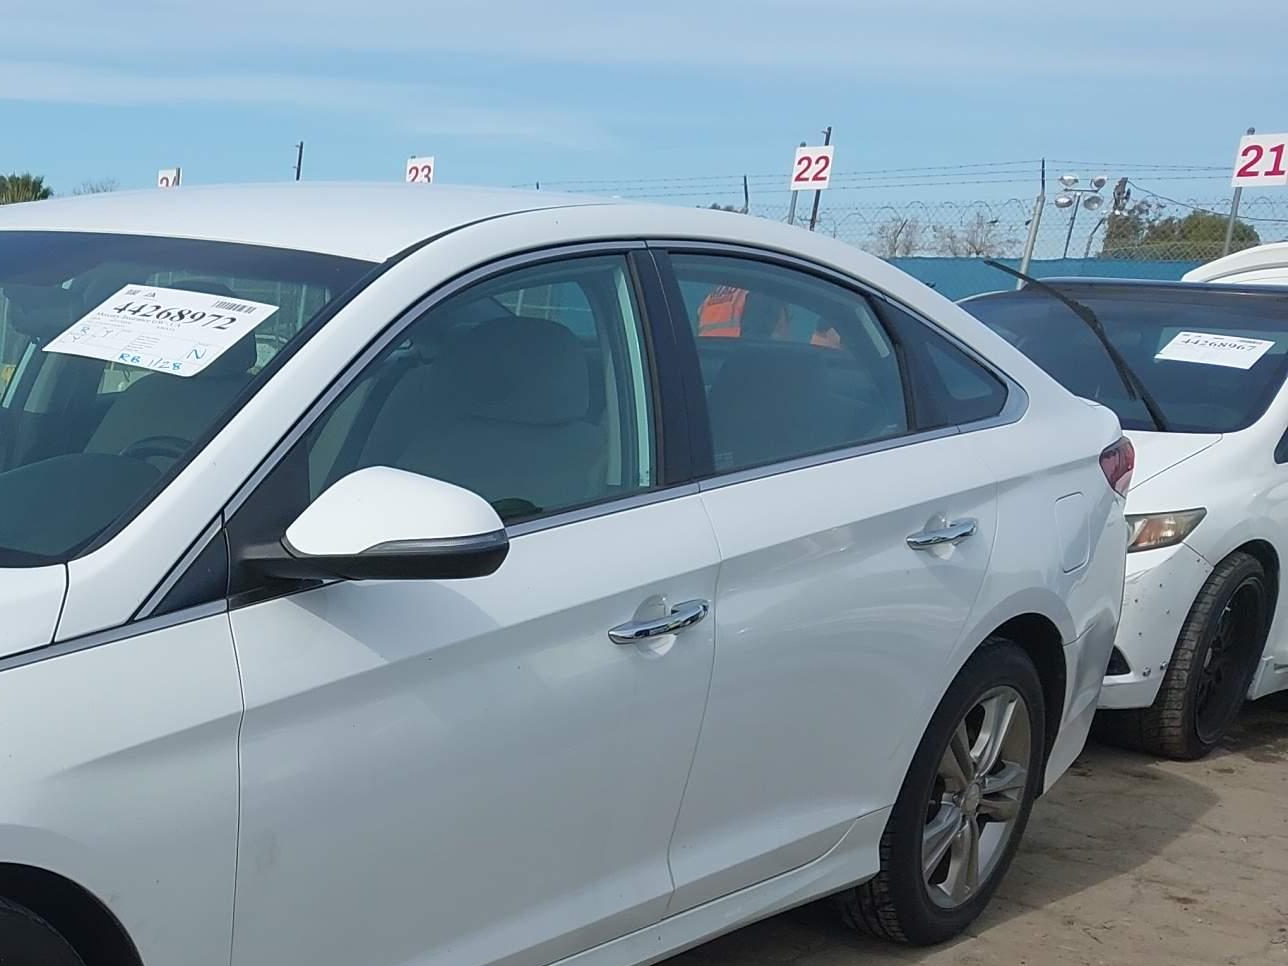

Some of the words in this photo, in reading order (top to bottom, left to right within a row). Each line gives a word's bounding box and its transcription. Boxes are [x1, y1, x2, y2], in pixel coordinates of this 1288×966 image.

[794, 155, 830, 182] 22
[1236, 144, 1285, 177] 21
[113, 301, 237, 331] 44268972
[1182, 338, 1256, 352] 44268967
[147, 357, 183, 370] 1/28
